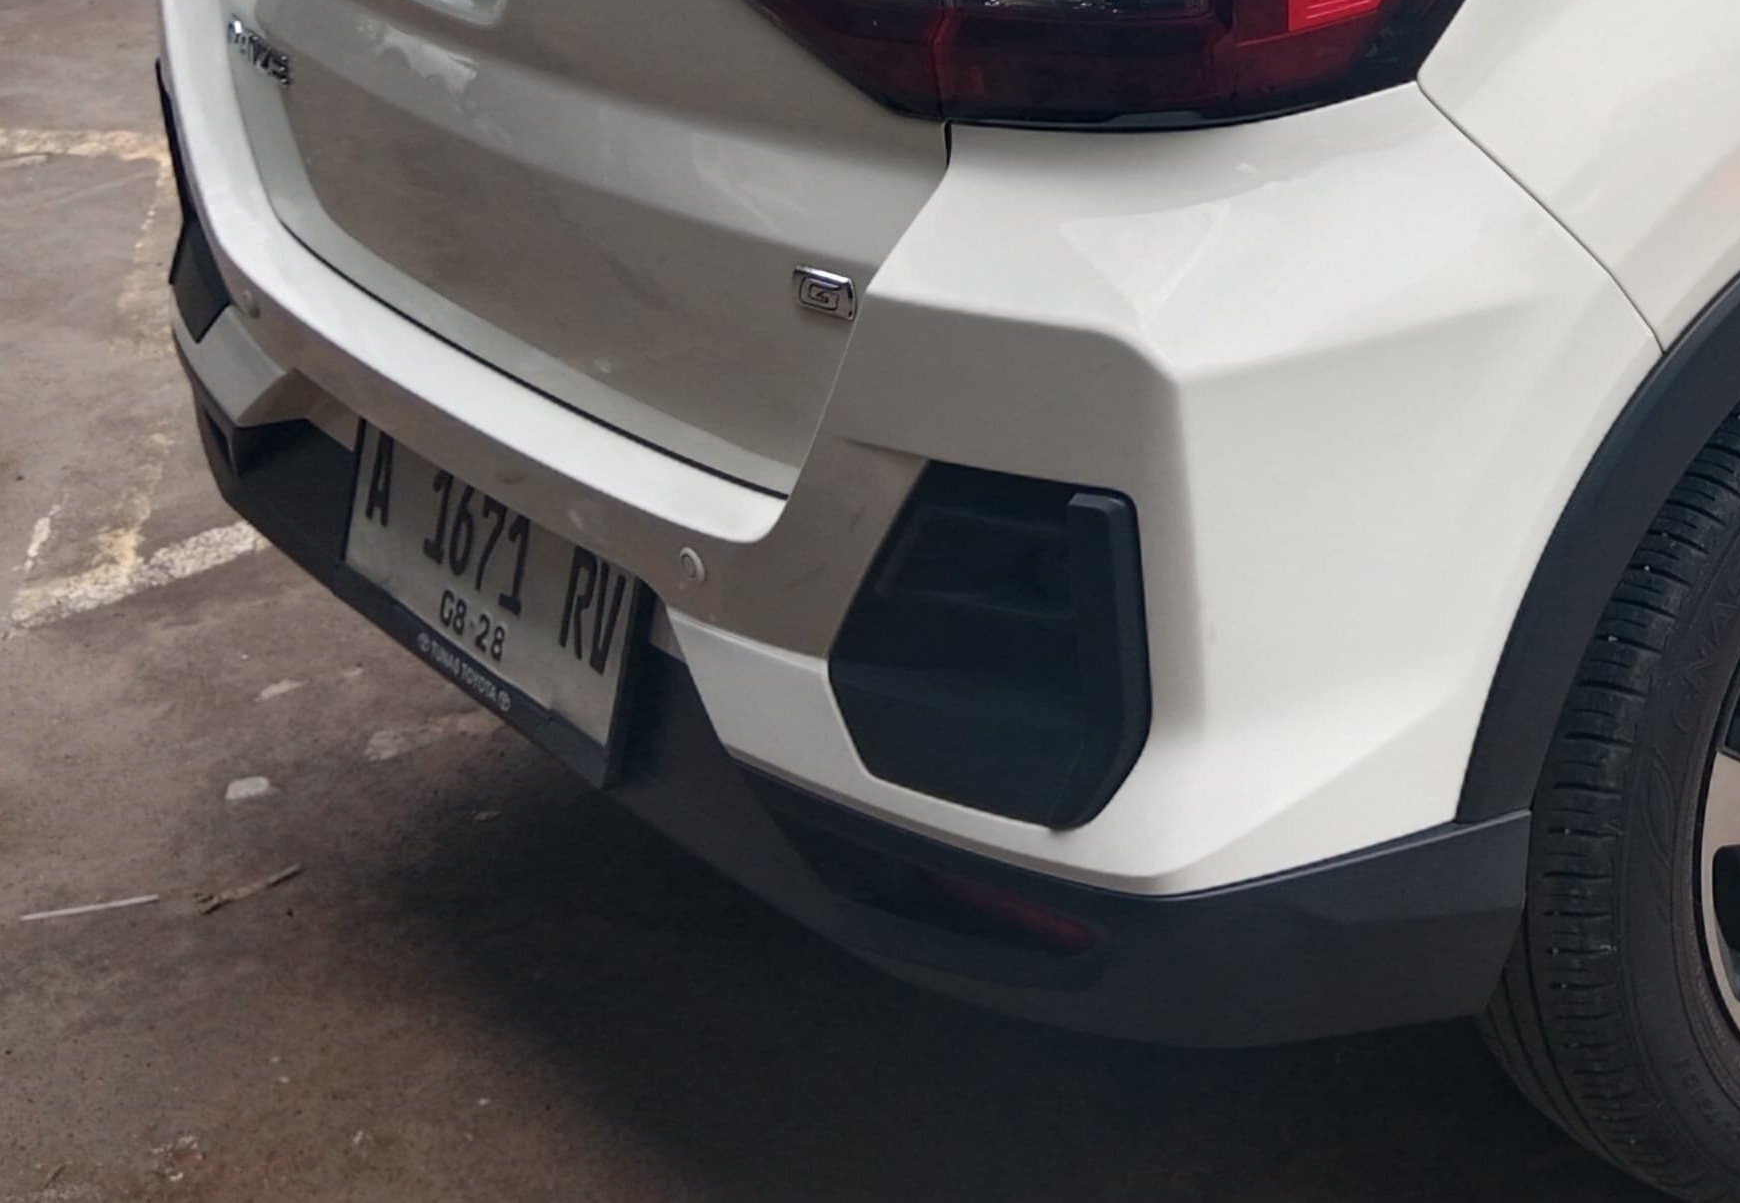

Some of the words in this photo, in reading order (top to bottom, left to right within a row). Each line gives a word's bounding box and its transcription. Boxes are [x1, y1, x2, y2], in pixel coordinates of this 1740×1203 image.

[364, 430, 396, 528] A
[422, 468, 532, 619] 1671
[557, 544, 628, 676] RV
